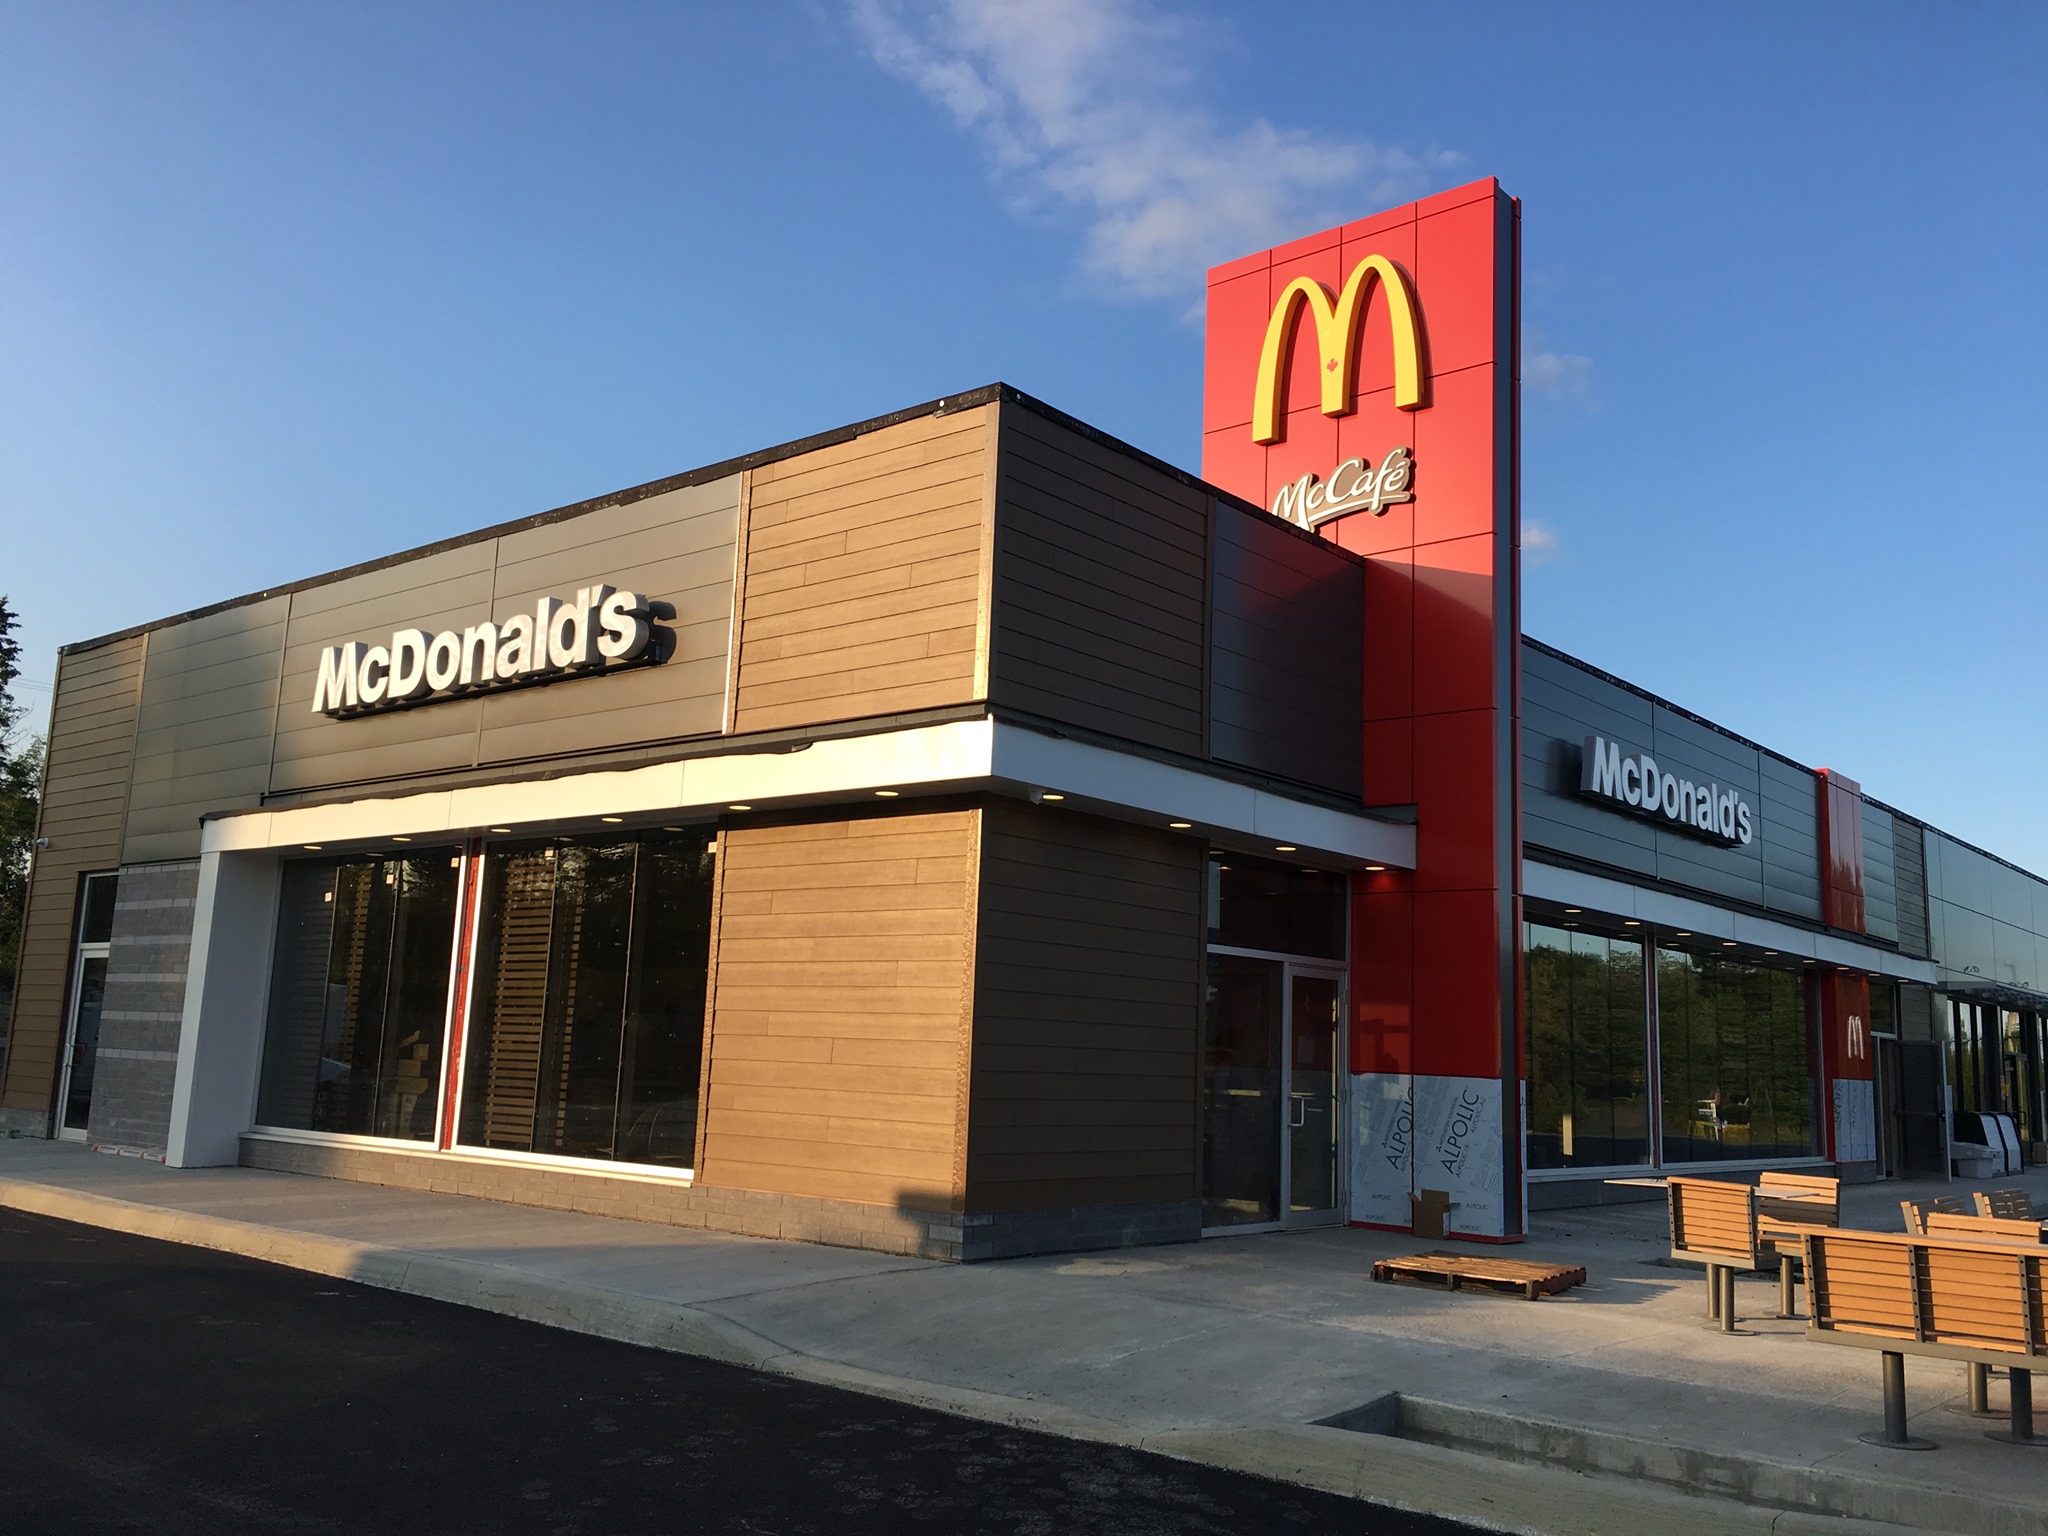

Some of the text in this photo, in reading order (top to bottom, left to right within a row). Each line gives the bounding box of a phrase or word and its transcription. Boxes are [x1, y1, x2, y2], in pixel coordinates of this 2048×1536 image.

[1271, 447, 1408, 532] McCafé
[311, 584, 646, 713] McDonald's
[1587, 735, 1752, 845] McDonald's
[1440, 1089, 1479, 1175] ALPOLIC
[1459, 1224, 1482, 1232] ALPOLIC
[1465, 1203, 1488, 1211] ALPOLIC
